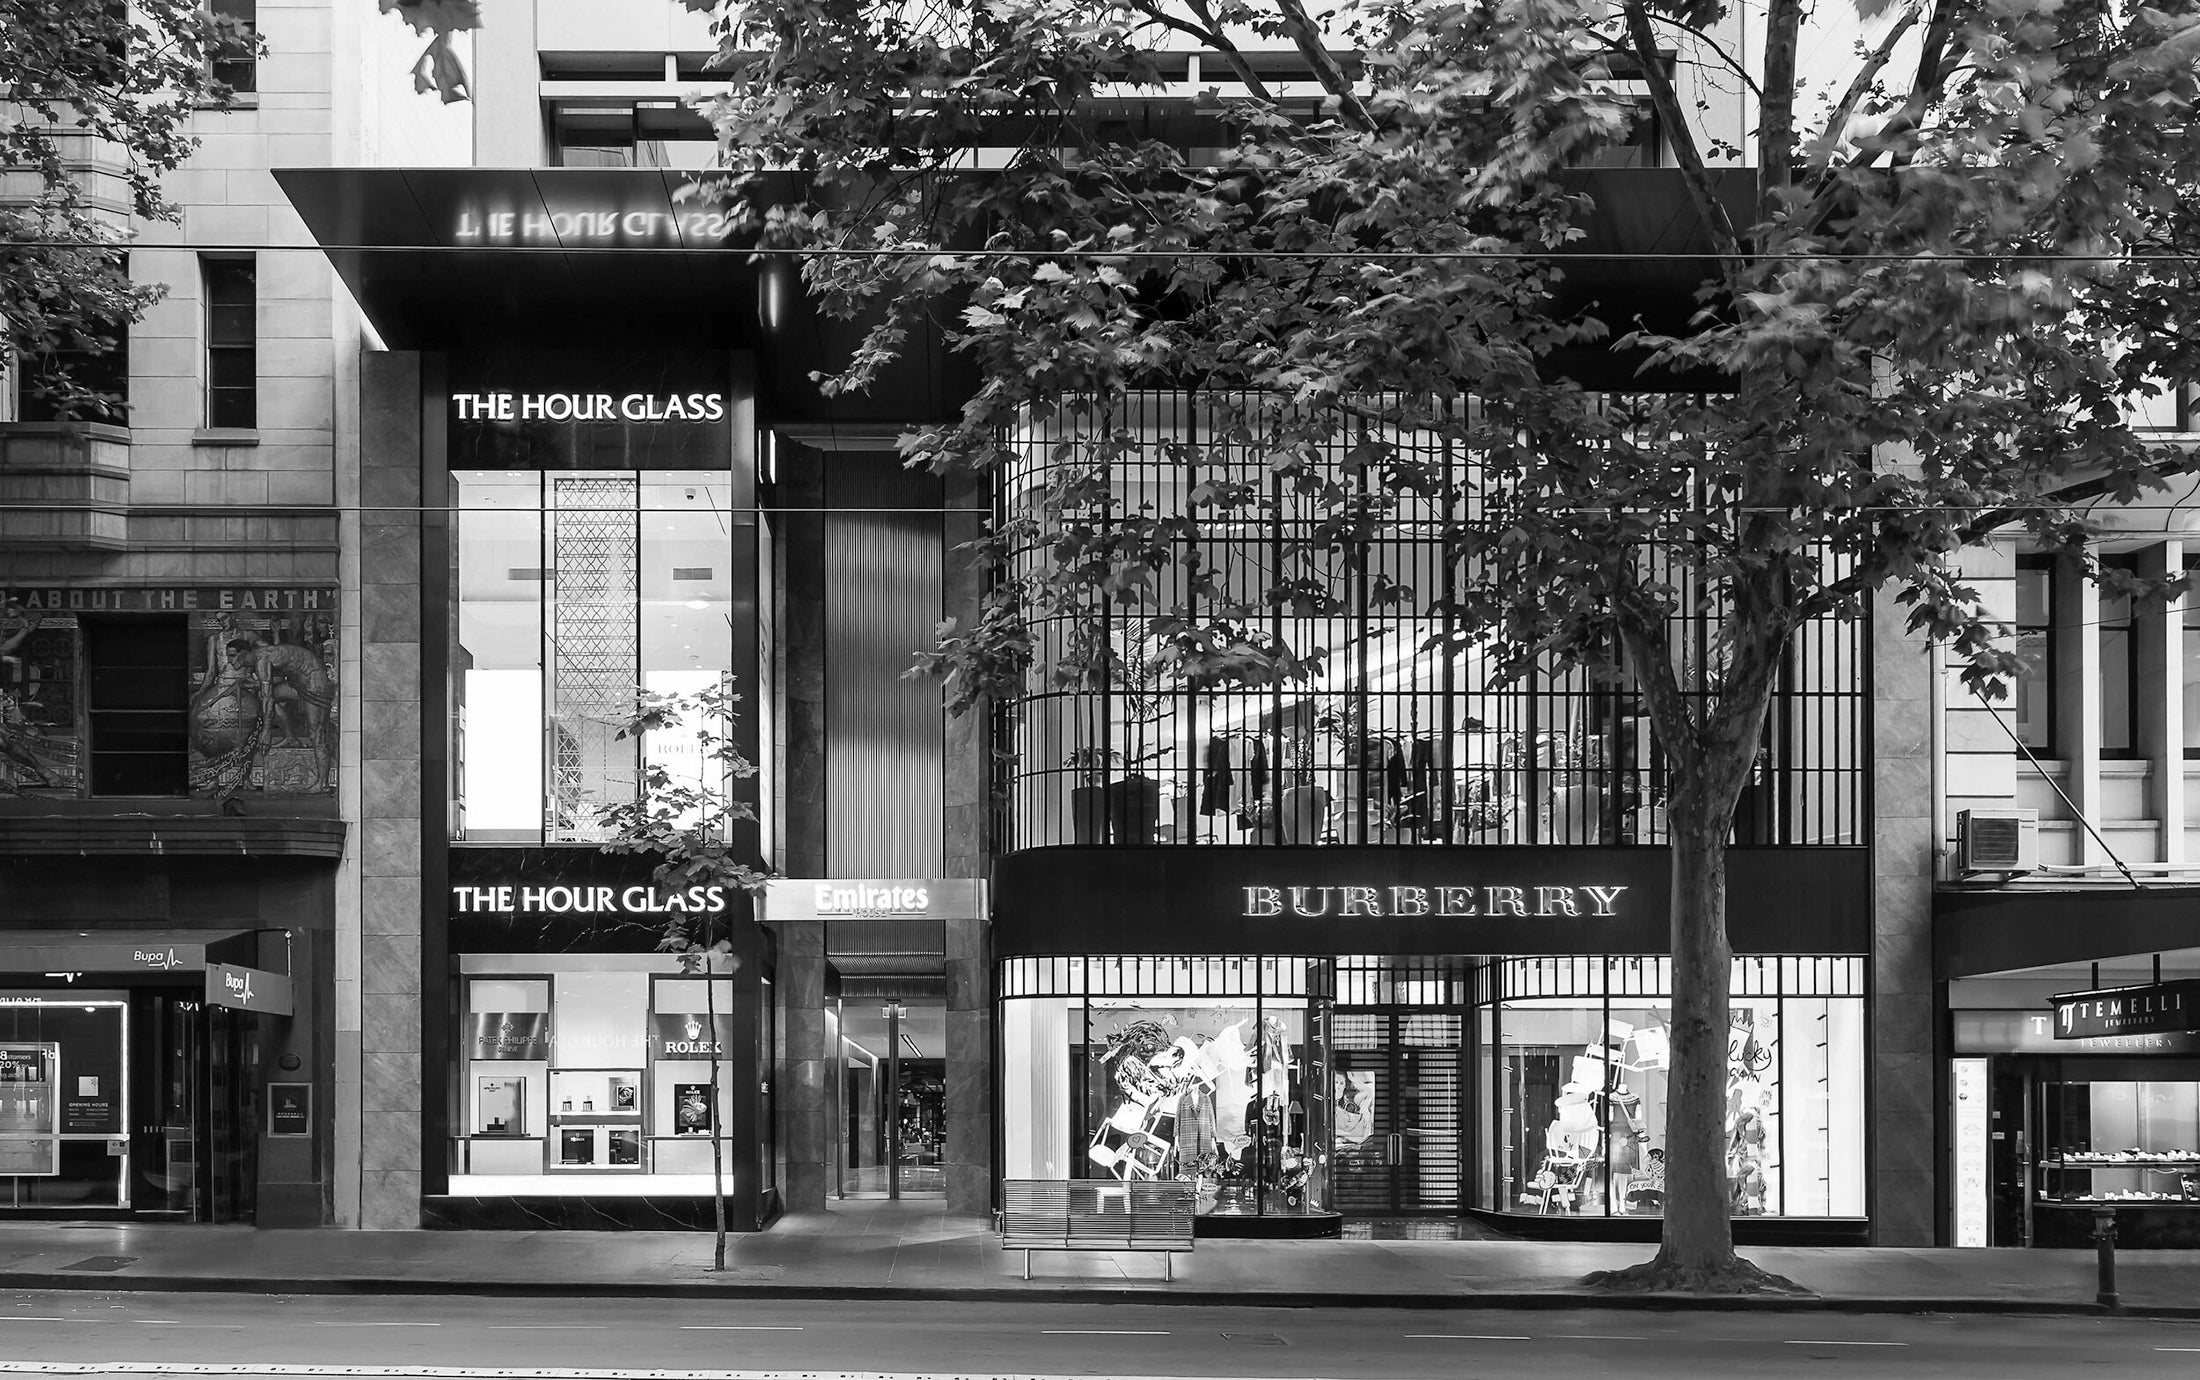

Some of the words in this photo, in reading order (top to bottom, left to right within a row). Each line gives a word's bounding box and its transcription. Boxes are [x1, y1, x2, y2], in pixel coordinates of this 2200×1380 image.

[452, 394, 514, 421] THE
[522, 393, 616, 421] HOUR
[621, 393, 724, 421] GLASS
[26, 590, 125, 609] ABOUT
[142, 590, 197, 609] THE
[453, 886, 515, 913] THE
[523, 886, 618, 913] HOUR
[622, 886, 726, 913] GLASS
[814, 883, 929, 910] Emirates
[1242, 886, 1628, 917] BURBERRY
[853, 908, 887, 917] HOUSE
[134, 950, 163, 962] Bupa
[226, 972, 243, 991] Bupa
[2079, 993, 2181, 1019] TEMELLI
[664, 1041, 722, 1054] ROLEX
[1728, 1039, 1772, 1071] lucky
